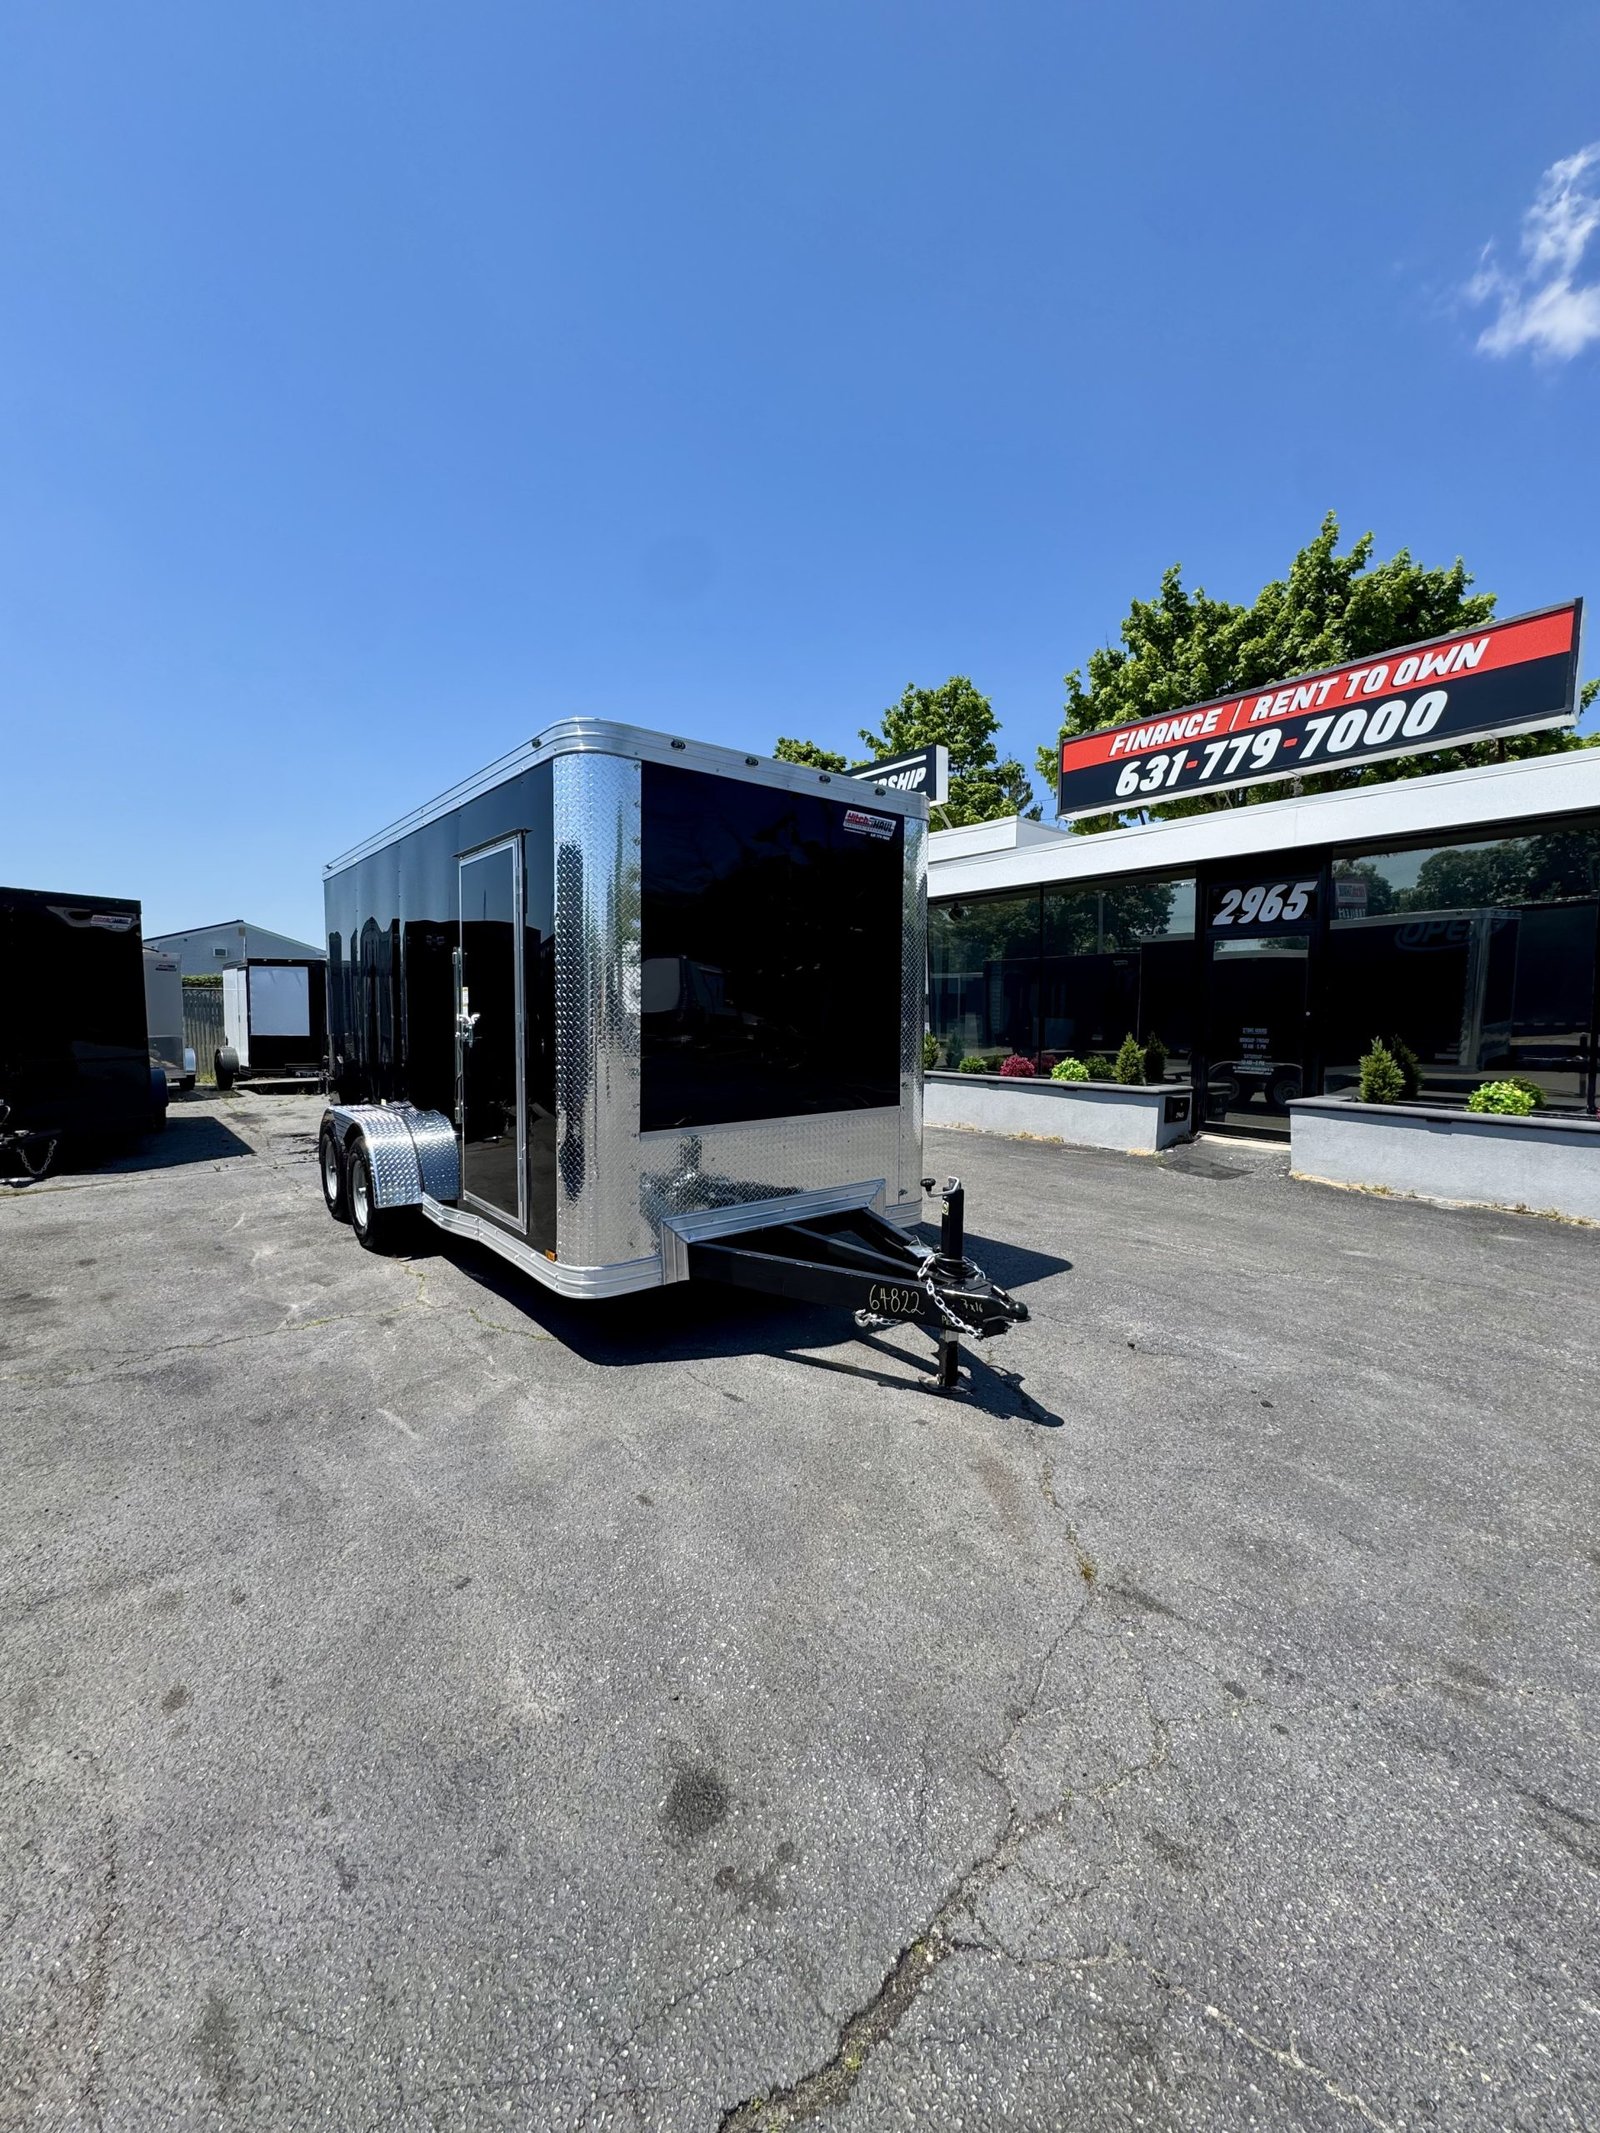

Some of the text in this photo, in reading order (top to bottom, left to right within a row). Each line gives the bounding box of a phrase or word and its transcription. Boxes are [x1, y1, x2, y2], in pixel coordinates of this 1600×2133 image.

[1108, 637, 1491, 757] FINANCE RENT TO OWN
[1115, 690, 1448, 797] 631-779-7000
[872, 766, 926, 791] SHIP
[1212, 881, 1318, 926] 2965
[869, 1284, 925, 1315] 64822
